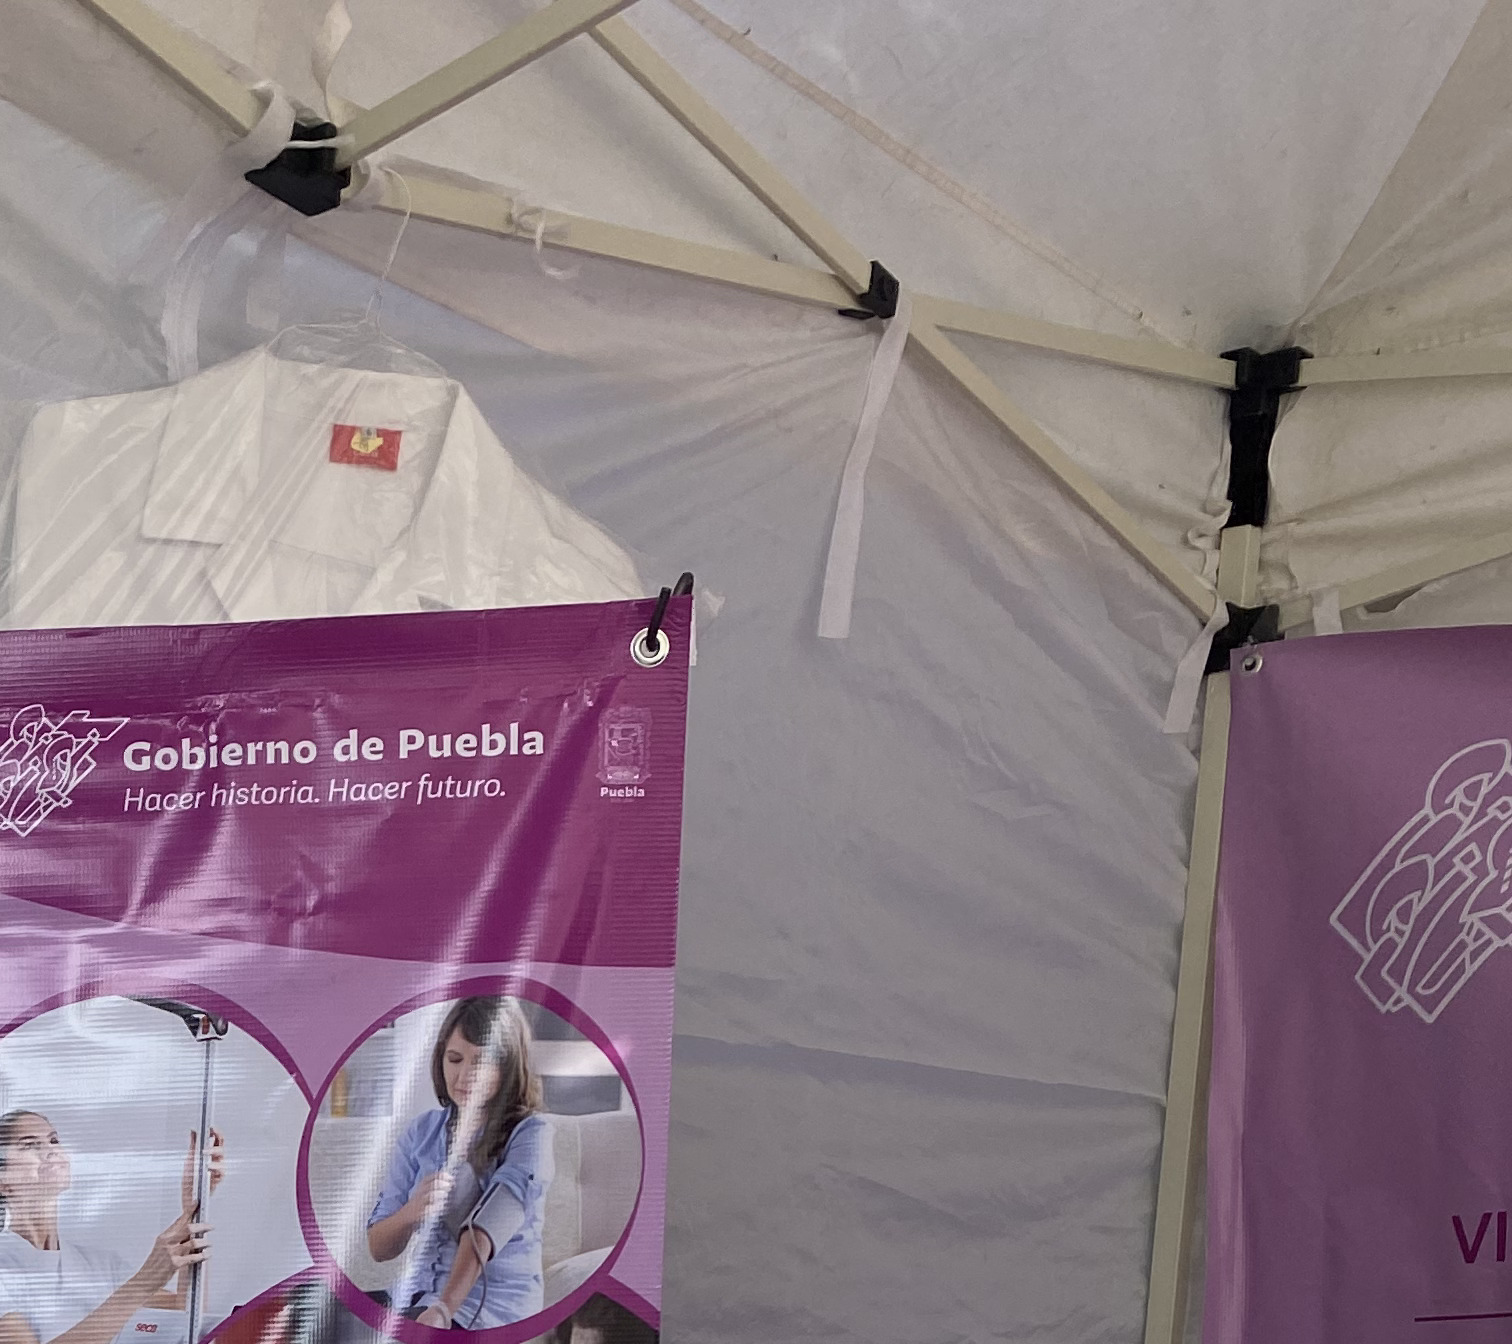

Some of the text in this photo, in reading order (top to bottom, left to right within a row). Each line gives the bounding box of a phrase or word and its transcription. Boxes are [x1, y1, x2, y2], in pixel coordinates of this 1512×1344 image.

[123, 721, 545, 771] Gobierno de Puebla
[123, 772, 507, 811] Hacer historia. Hacer futuro.
[600, 786, 645, 797] Puebla
